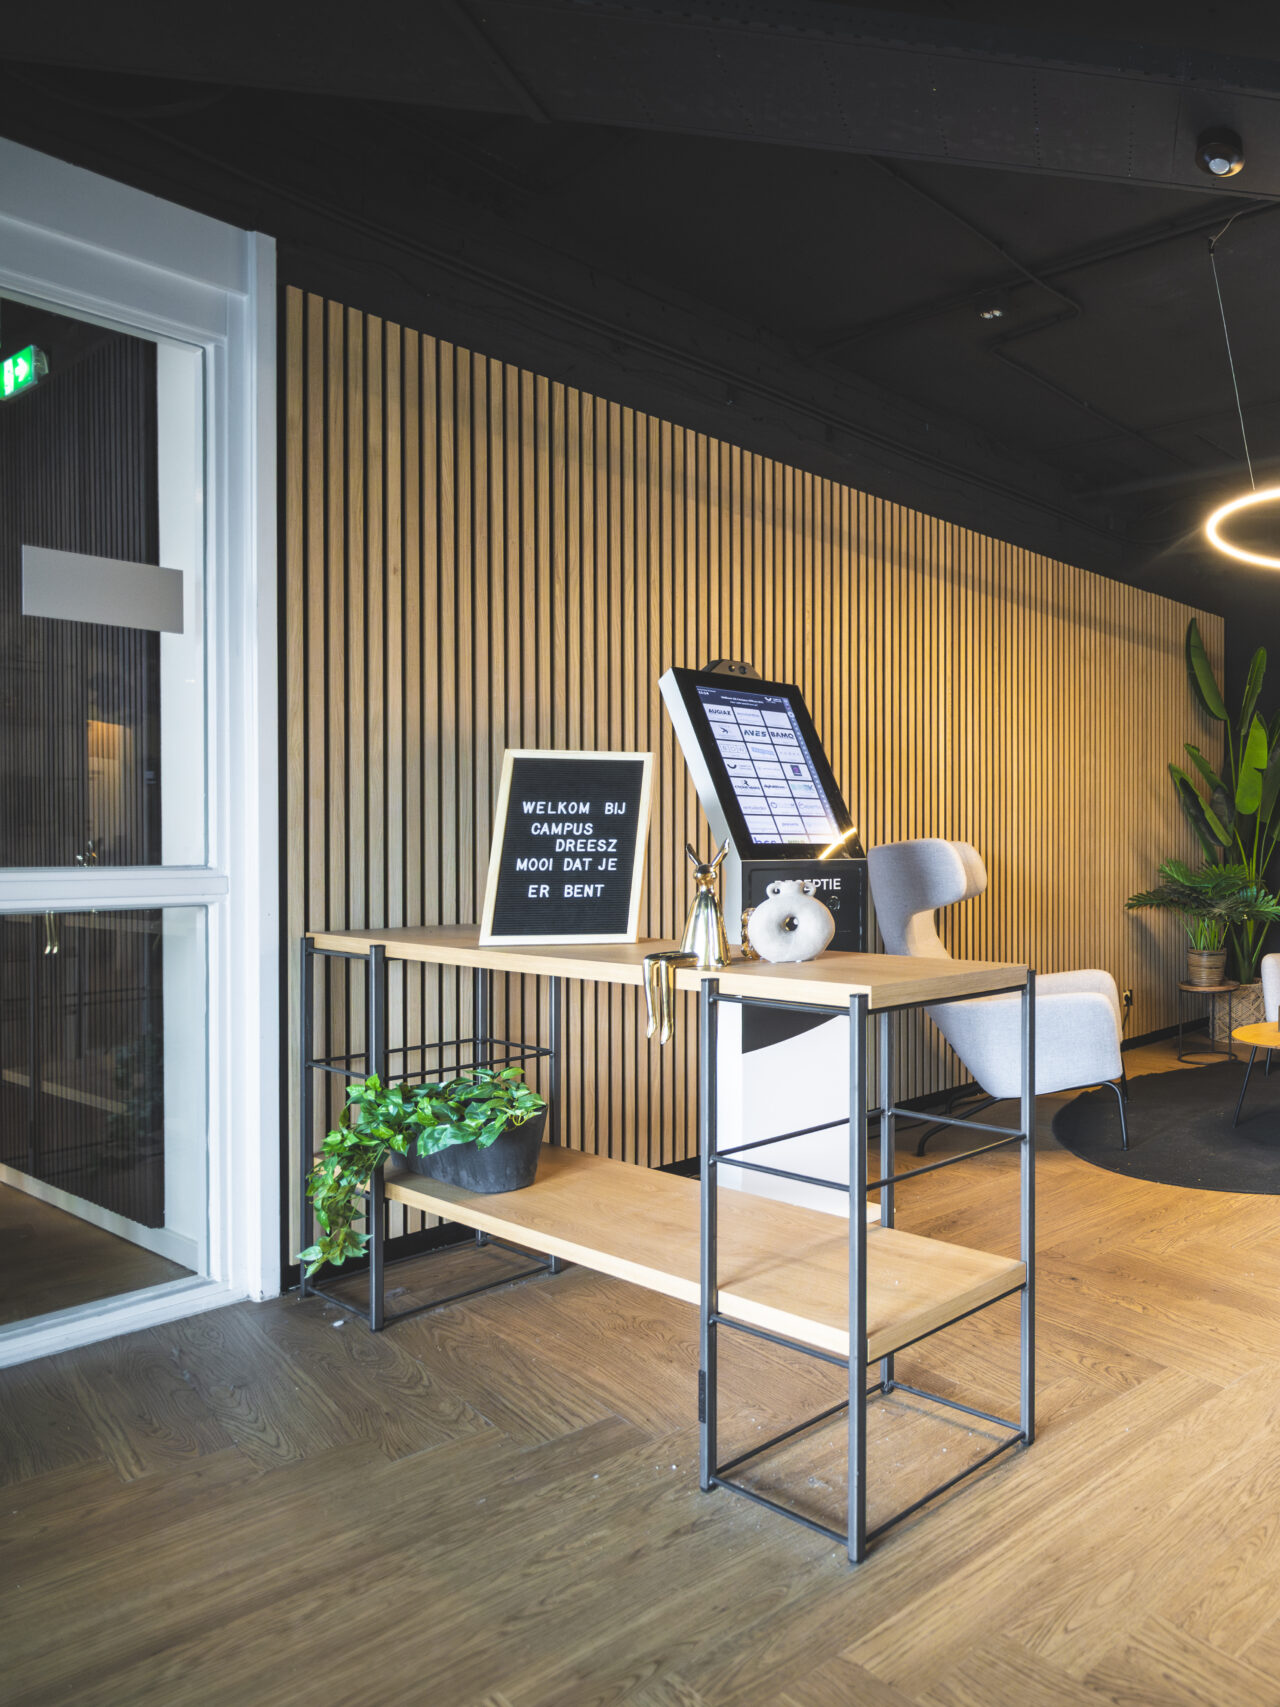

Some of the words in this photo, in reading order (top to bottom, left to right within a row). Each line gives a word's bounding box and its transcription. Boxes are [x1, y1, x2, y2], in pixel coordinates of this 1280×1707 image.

[522, 801, 590, 814] WELKOM
[604, 802, 626, 815] BIJ
[531, 822, 593, 835] CAMPUS
[555, 839, 617, 852] DREESZ
[516, 858, 553, 871] MOOI
[563, 858, 592, 871] DAT
[598, 858, 618, 871] JE
[528, 885, 549, 898] ER
[564, 884, 604, 898] BENT
